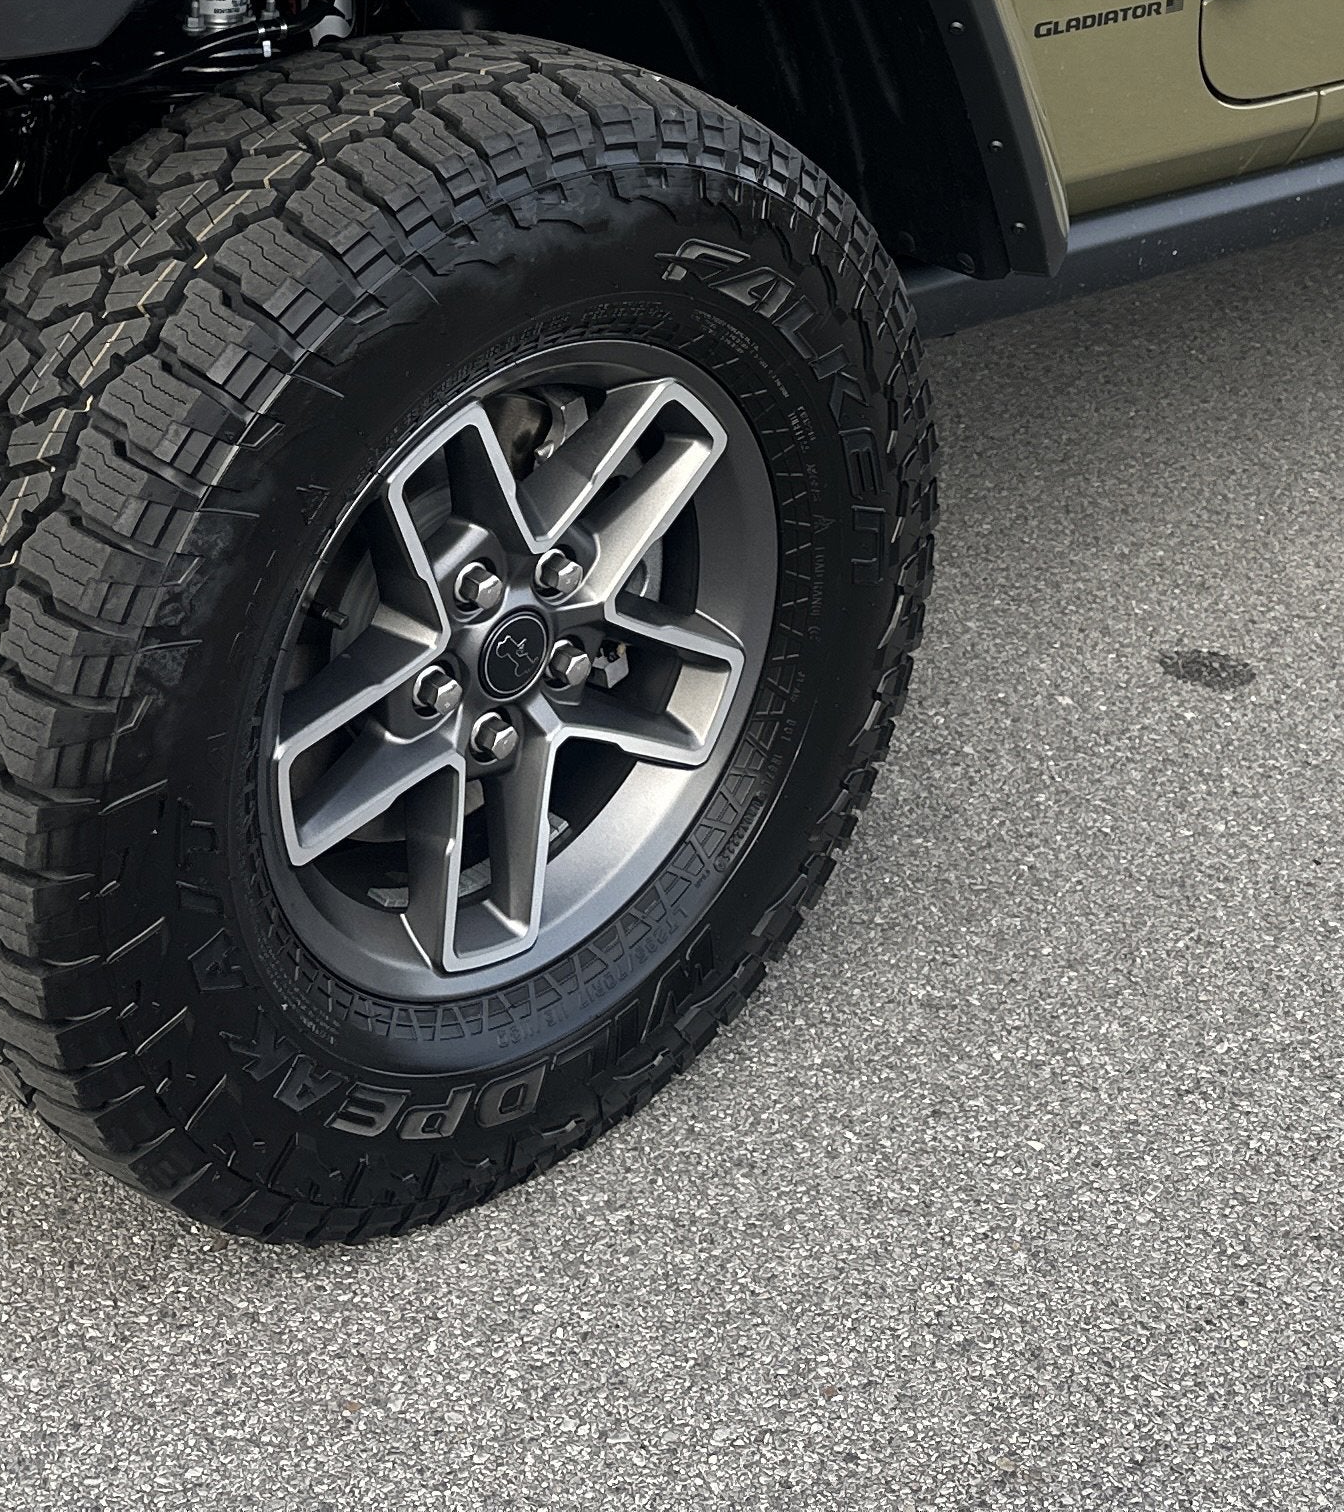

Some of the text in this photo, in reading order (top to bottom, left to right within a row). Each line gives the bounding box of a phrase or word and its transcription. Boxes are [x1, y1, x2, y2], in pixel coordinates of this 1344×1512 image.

[1034, 1, 1162, 38] GLADIATOR
[654, 237, 887, 585] FALKEN
[218, 923, 714, 1139] WILDPEAK
